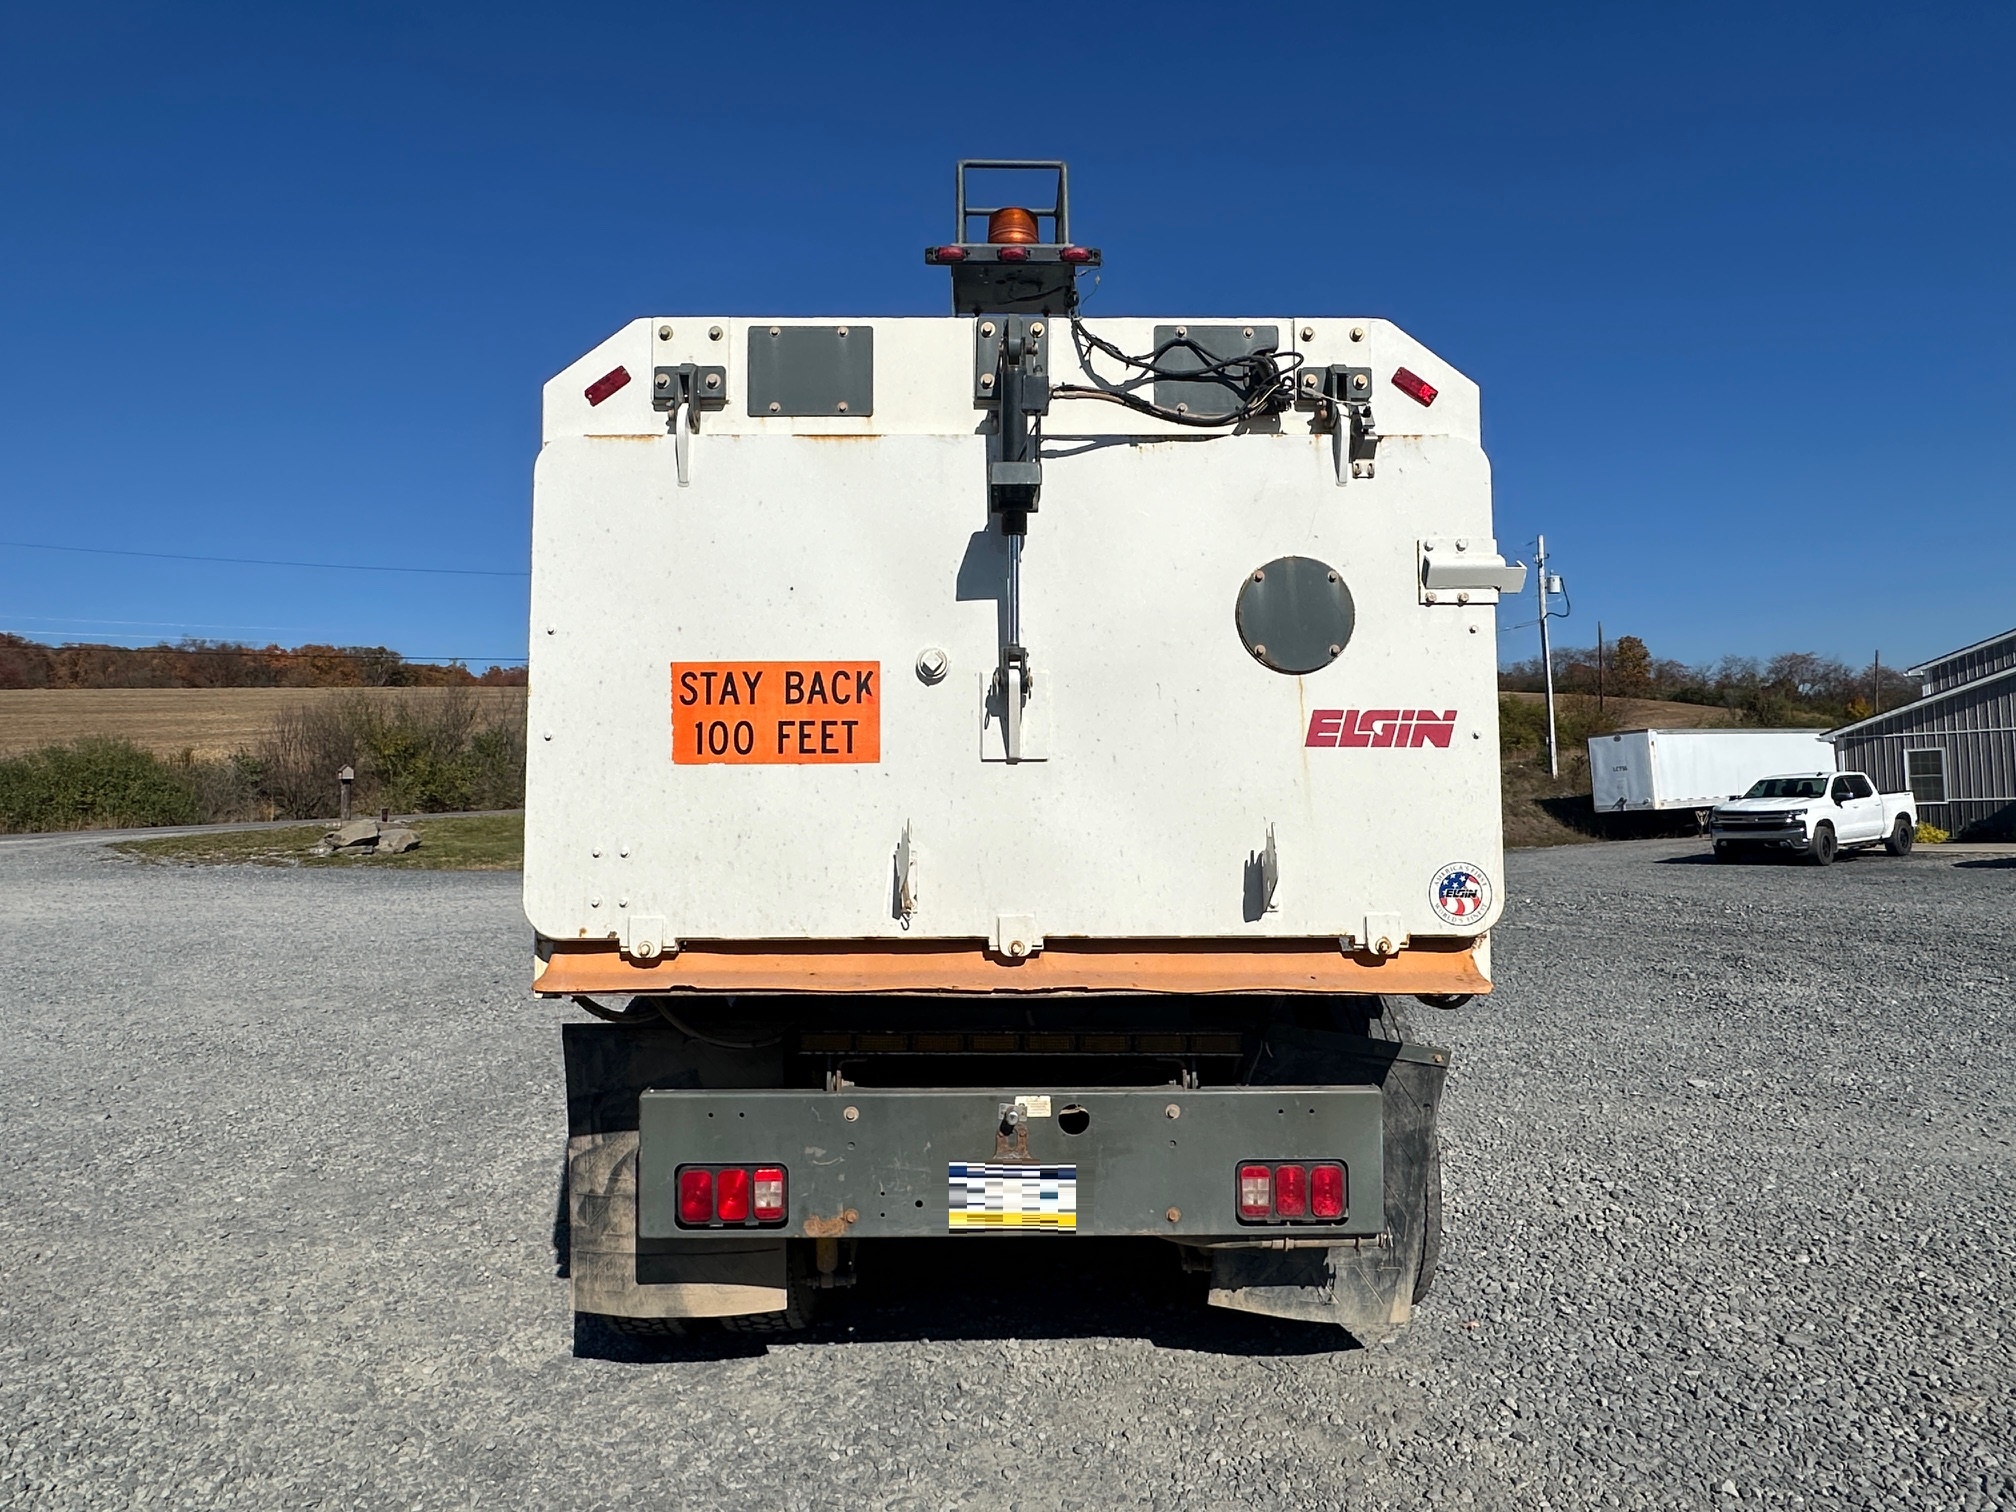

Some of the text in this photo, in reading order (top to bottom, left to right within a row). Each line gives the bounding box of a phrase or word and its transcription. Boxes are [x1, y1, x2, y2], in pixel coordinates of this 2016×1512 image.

[679, 671, 874, 705] STAY BACK
[695, 720, 859, 755] 100 FEET
